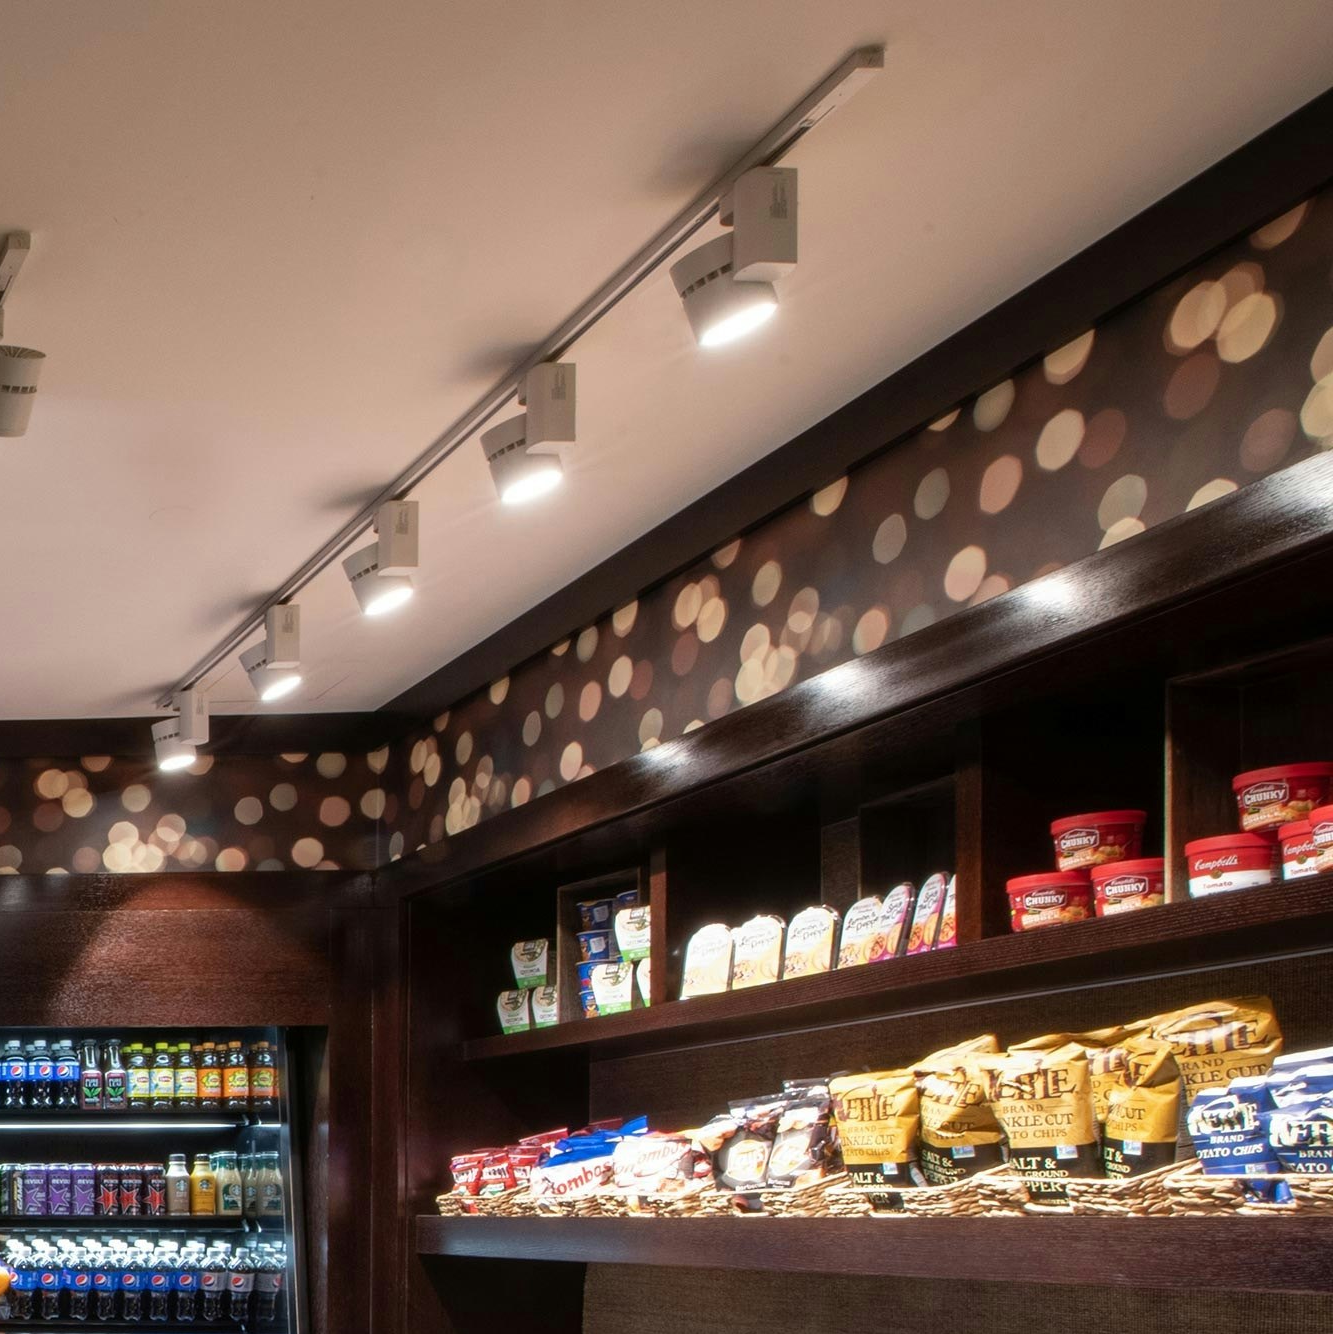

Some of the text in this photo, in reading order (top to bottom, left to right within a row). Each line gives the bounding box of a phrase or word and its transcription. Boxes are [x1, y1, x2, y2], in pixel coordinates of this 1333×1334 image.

[1245, 789, 1285, 804] CHUNKY
[1061, 835, 1095, 849] CHUNKY
[1195, 855, 1238, 871] Campbell's
[1105, 882, 1145, 896] CHUNKY
[1025, 894, 1064, 906] CHUNKY
[1226, 1064, 1266, 1079] CUT
[1003, 1104, 1044, 1113] BRAND
[1045, 1113, 1073, 1125] CUT
[876, 1135, 895, 1144] CUT
[1033, 1129, 1068, 1138] CHIPS
[1210, 1135, 1244, 1144] BRAND
[1233, 1144, 1263, 1156] CHIPS
[922, 1150, 952, 1166] SALT &
[1115, 1152, 1122, 1162] &
[1045, 1158, 1056, 1169] &
[875, 1173, 884, 1182] &
